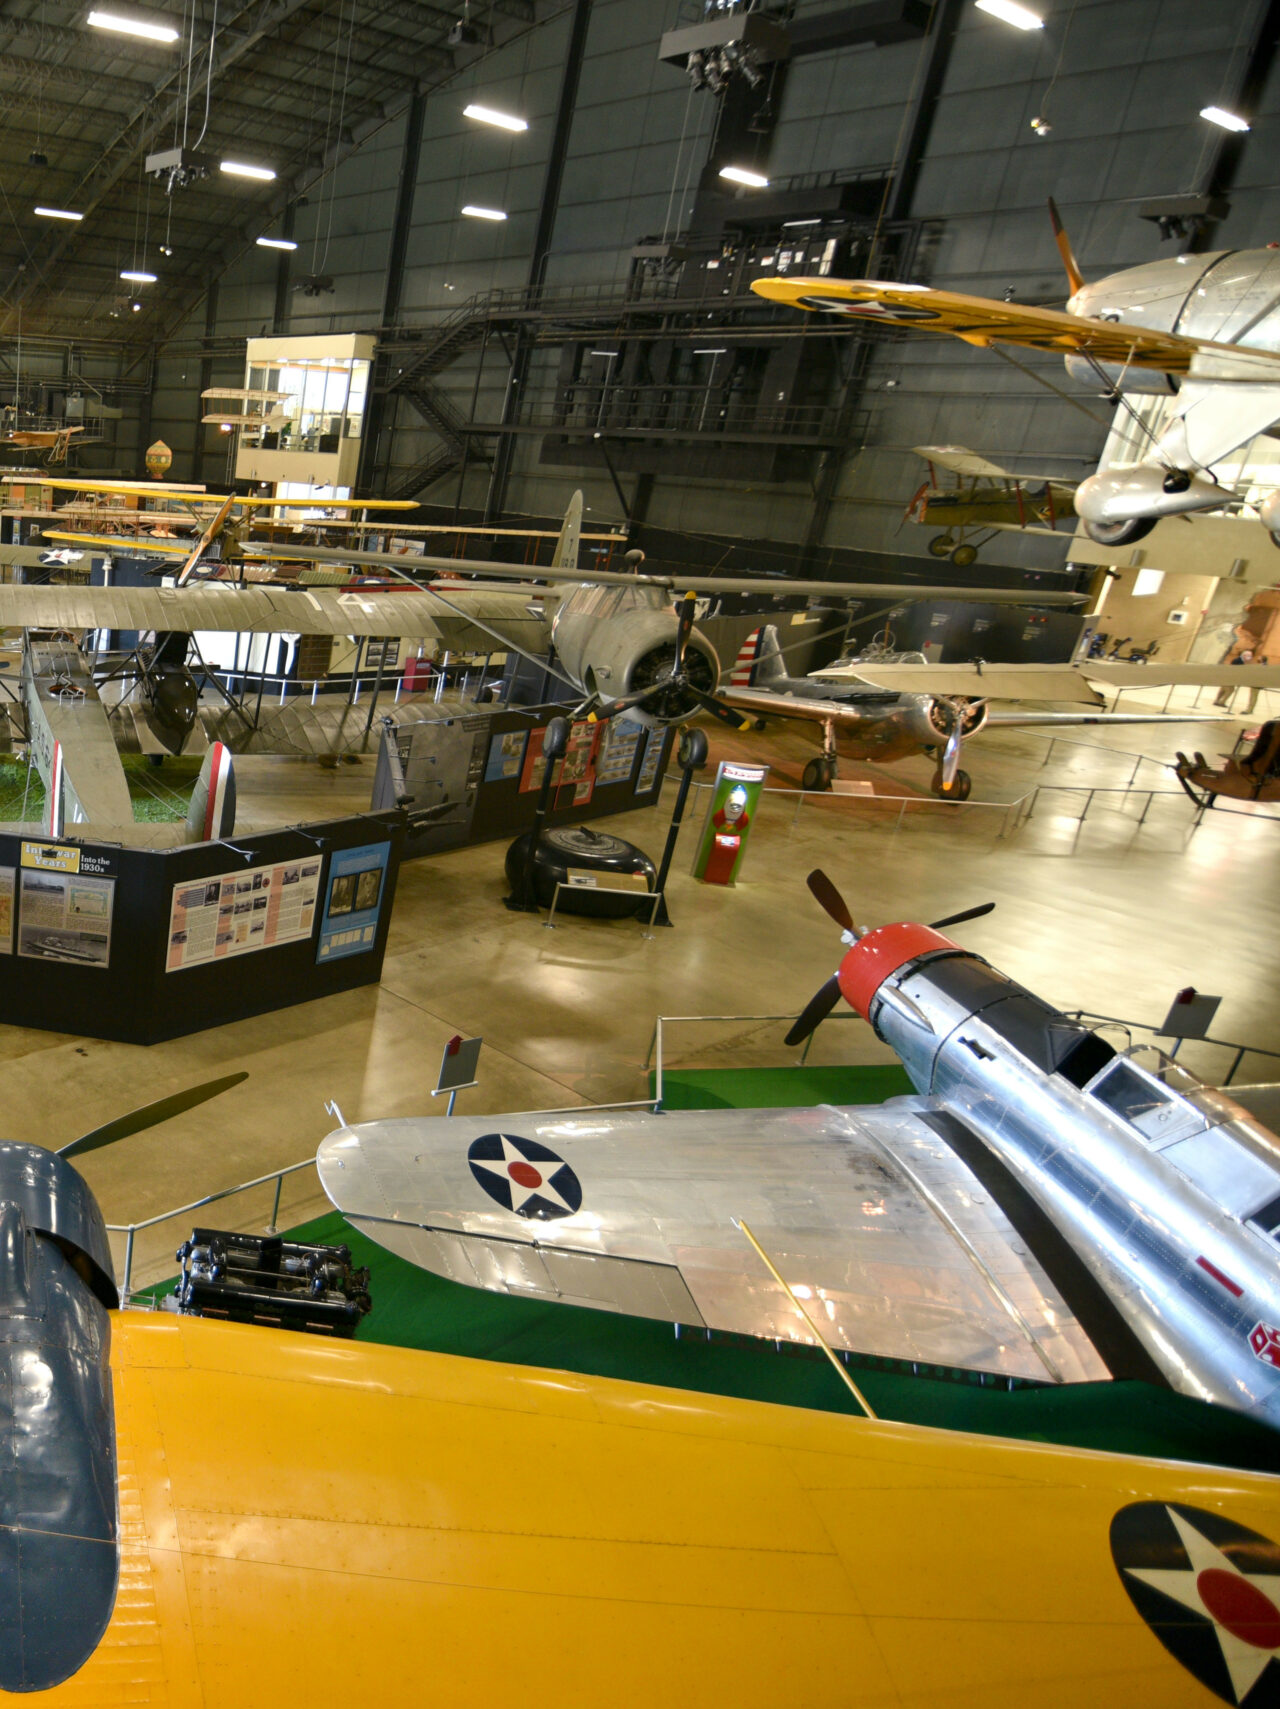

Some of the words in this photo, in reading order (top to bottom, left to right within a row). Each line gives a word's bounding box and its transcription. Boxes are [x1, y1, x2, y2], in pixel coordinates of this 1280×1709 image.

[25, 844, 76, 859] Intwar
[34, 855, 67, 868] Years
[81, 854, 97, 864] Into
[97, 856, 111, 866] the
[80, 863, 105, 873] 1930s
